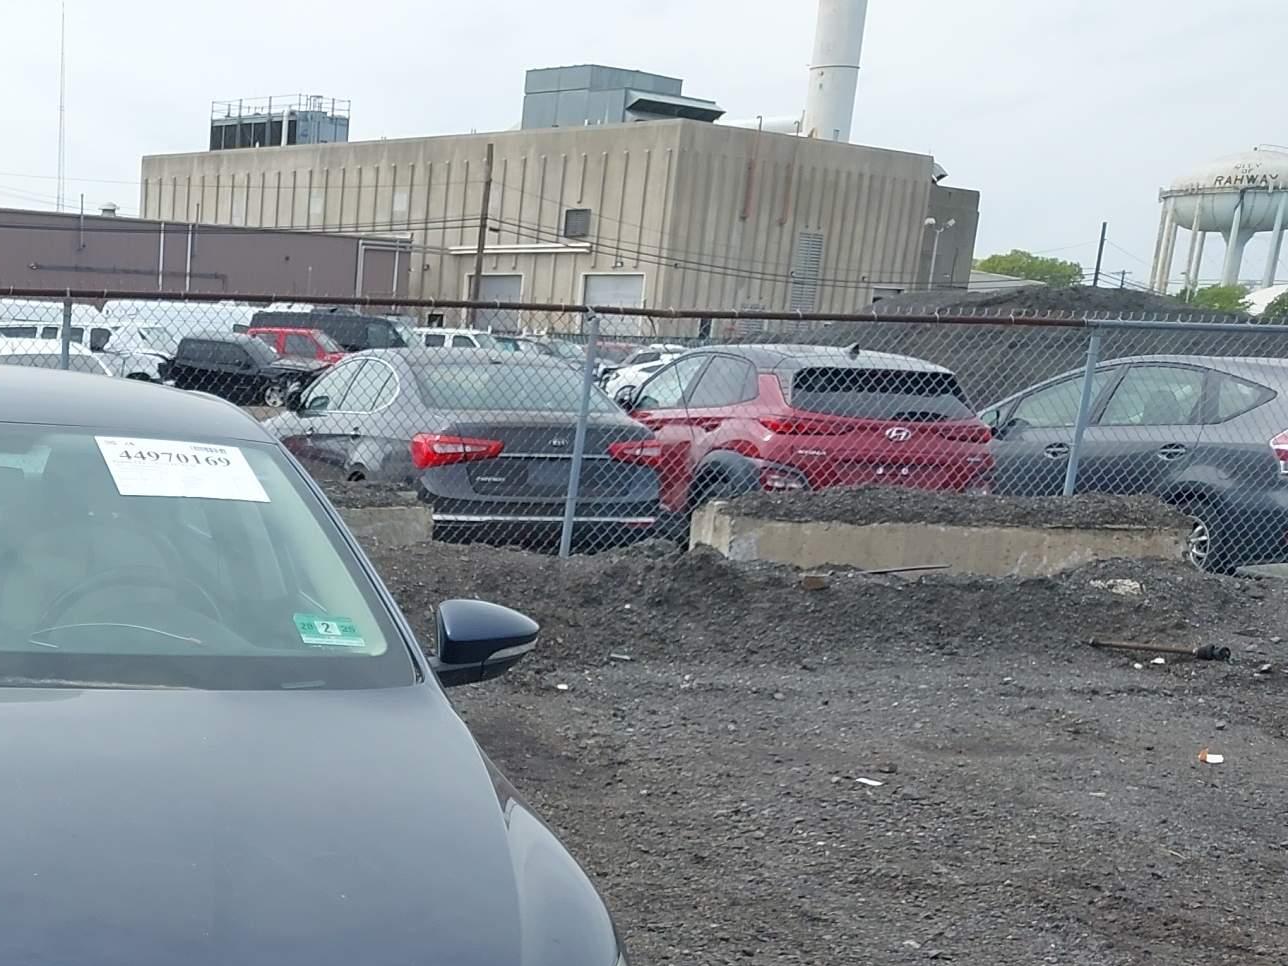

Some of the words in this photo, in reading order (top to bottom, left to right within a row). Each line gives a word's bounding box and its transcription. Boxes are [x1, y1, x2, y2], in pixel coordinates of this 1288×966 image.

[1215, 174, 1279, 185] RAHWAY
[119, 449, 231, 467] 44970169
[321, 622, 333, 633] 2
